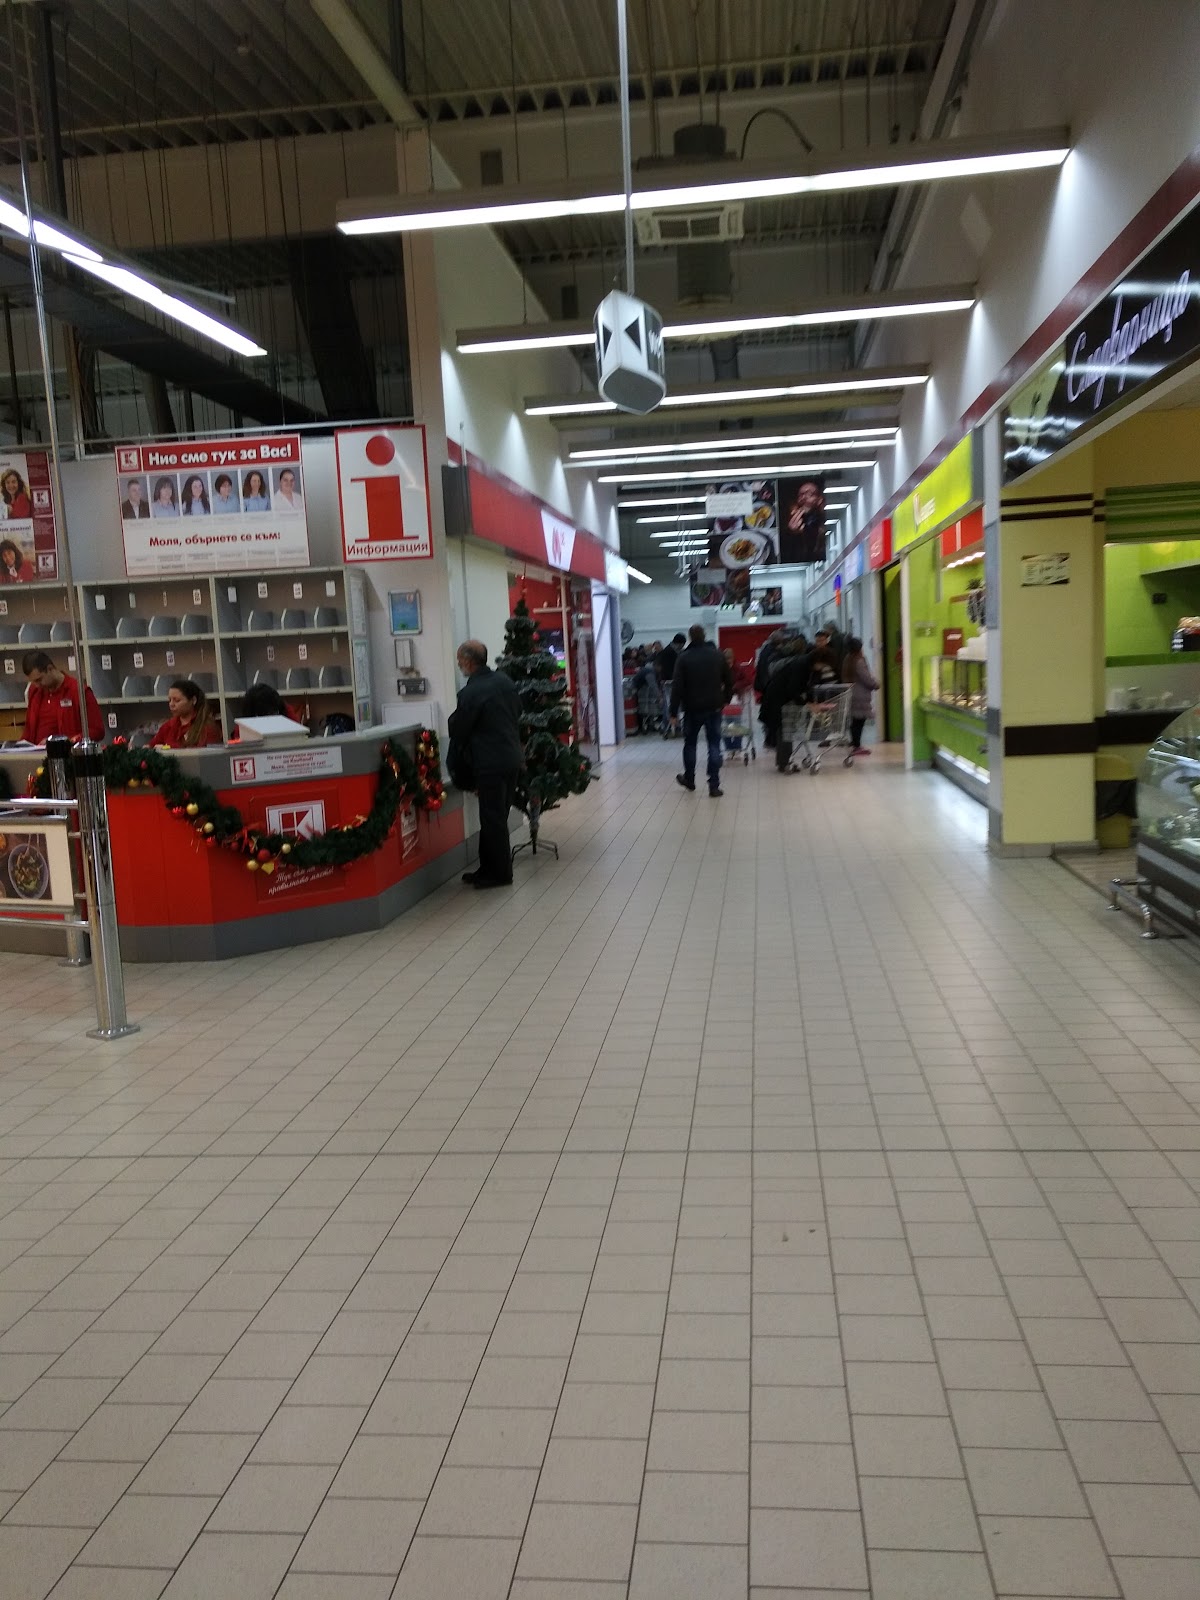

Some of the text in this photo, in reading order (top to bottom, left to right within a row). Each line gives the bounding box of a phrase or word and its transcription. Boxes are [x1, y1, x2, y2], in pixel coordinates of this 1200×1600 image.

[148, 443, 292, 466] Ние сме тук за Вас!
[149, 531, 281, 547] Моля, обърнете се към:
[347, 543, 428, 557] Информация
